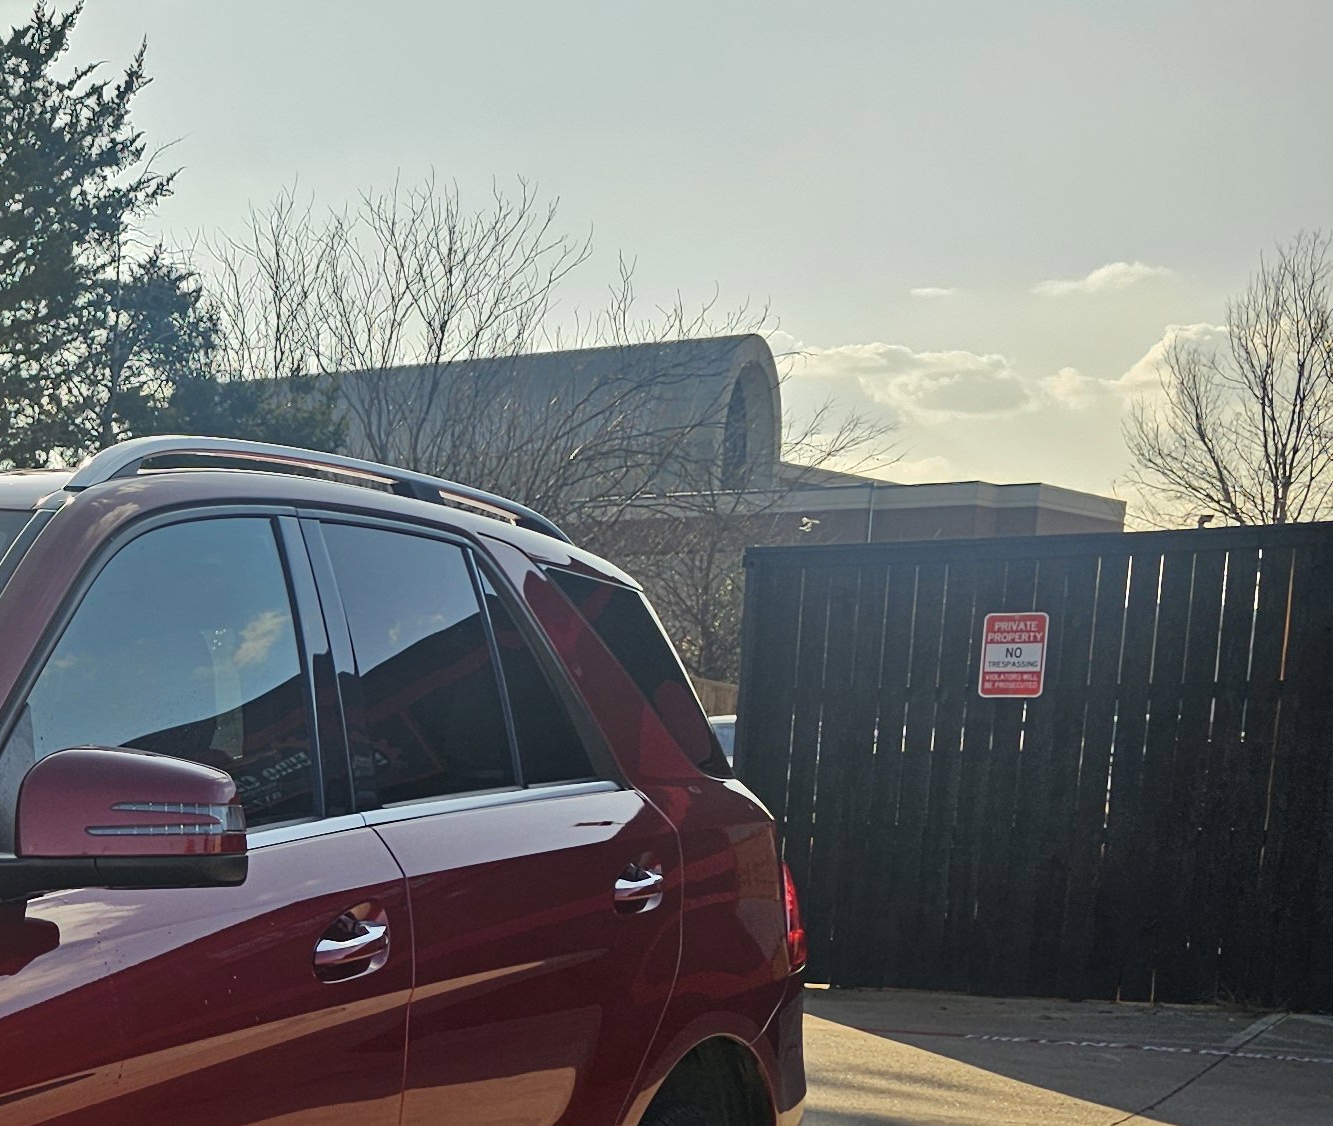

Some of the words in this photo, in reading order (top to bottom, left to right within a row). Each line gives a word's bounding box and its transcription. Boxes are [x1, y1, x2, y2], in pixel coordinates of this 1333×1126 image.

[994, 621, 1038, 631] PRIVATE
[987, 632, 1043, 642] PROPERTY
[1005, 647, 1023, 659] NO
[988, 660, 1038, 668] TRESPASSING
[985, 673, 1021, 681] VIOLATORS
[1022, 673, 1038, 681] WILL
[994, 681, 1038, 689] PROSECUTED
